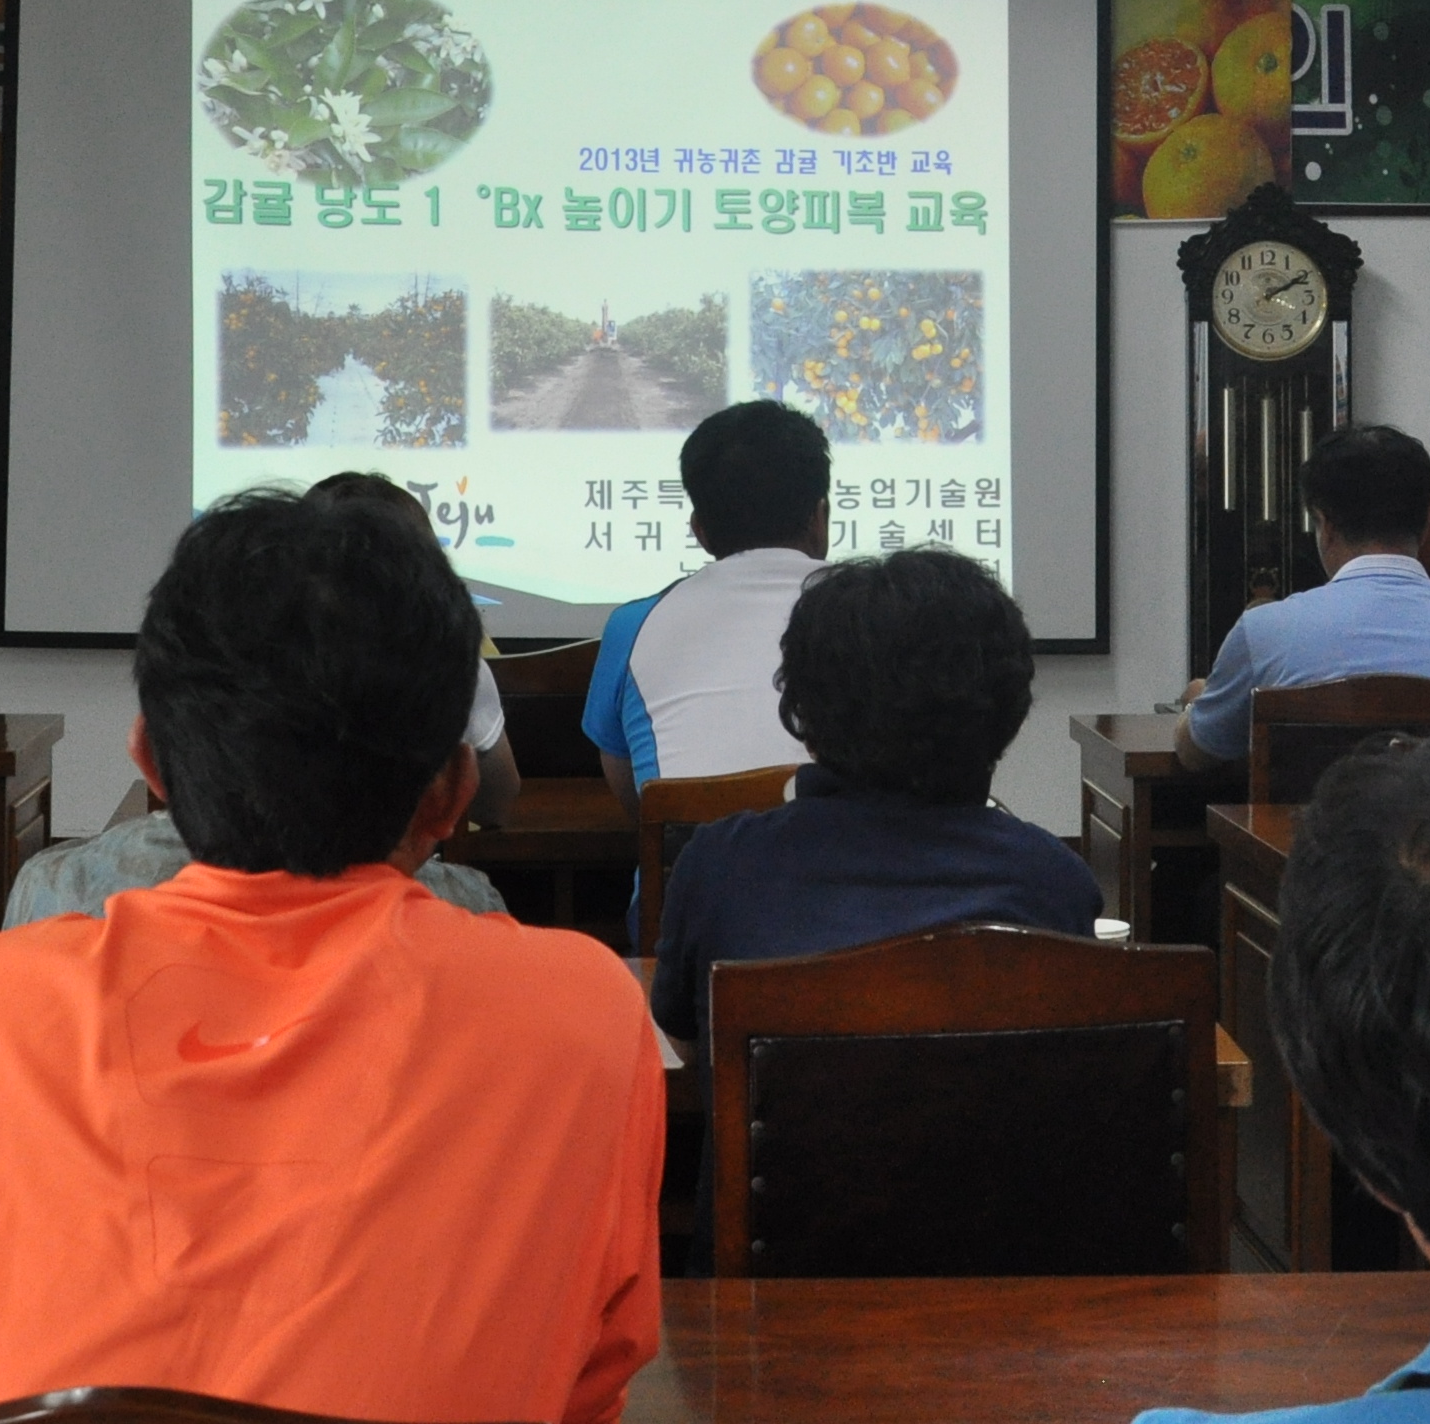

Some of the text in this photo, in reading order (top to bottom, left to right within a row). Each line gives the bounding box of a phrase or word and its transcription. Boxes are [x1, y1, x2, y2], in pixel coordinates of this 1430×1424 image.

[579, 147, 953, 176] 2013년 귀농귀촌 감귤 기초반 교육
[202, 178, 294, 227] 감귤
[315, 182, 402, 229] 당도
[424, 185, 440, 227] 1
[562, 186, 692, 233] 높이기
[713, 188, 887, 235] 토양피복
[905, 189, 989, 236] 교육
[407, 476, 495, 550] Jeju
[584, 479, 685, 510] 제주특
